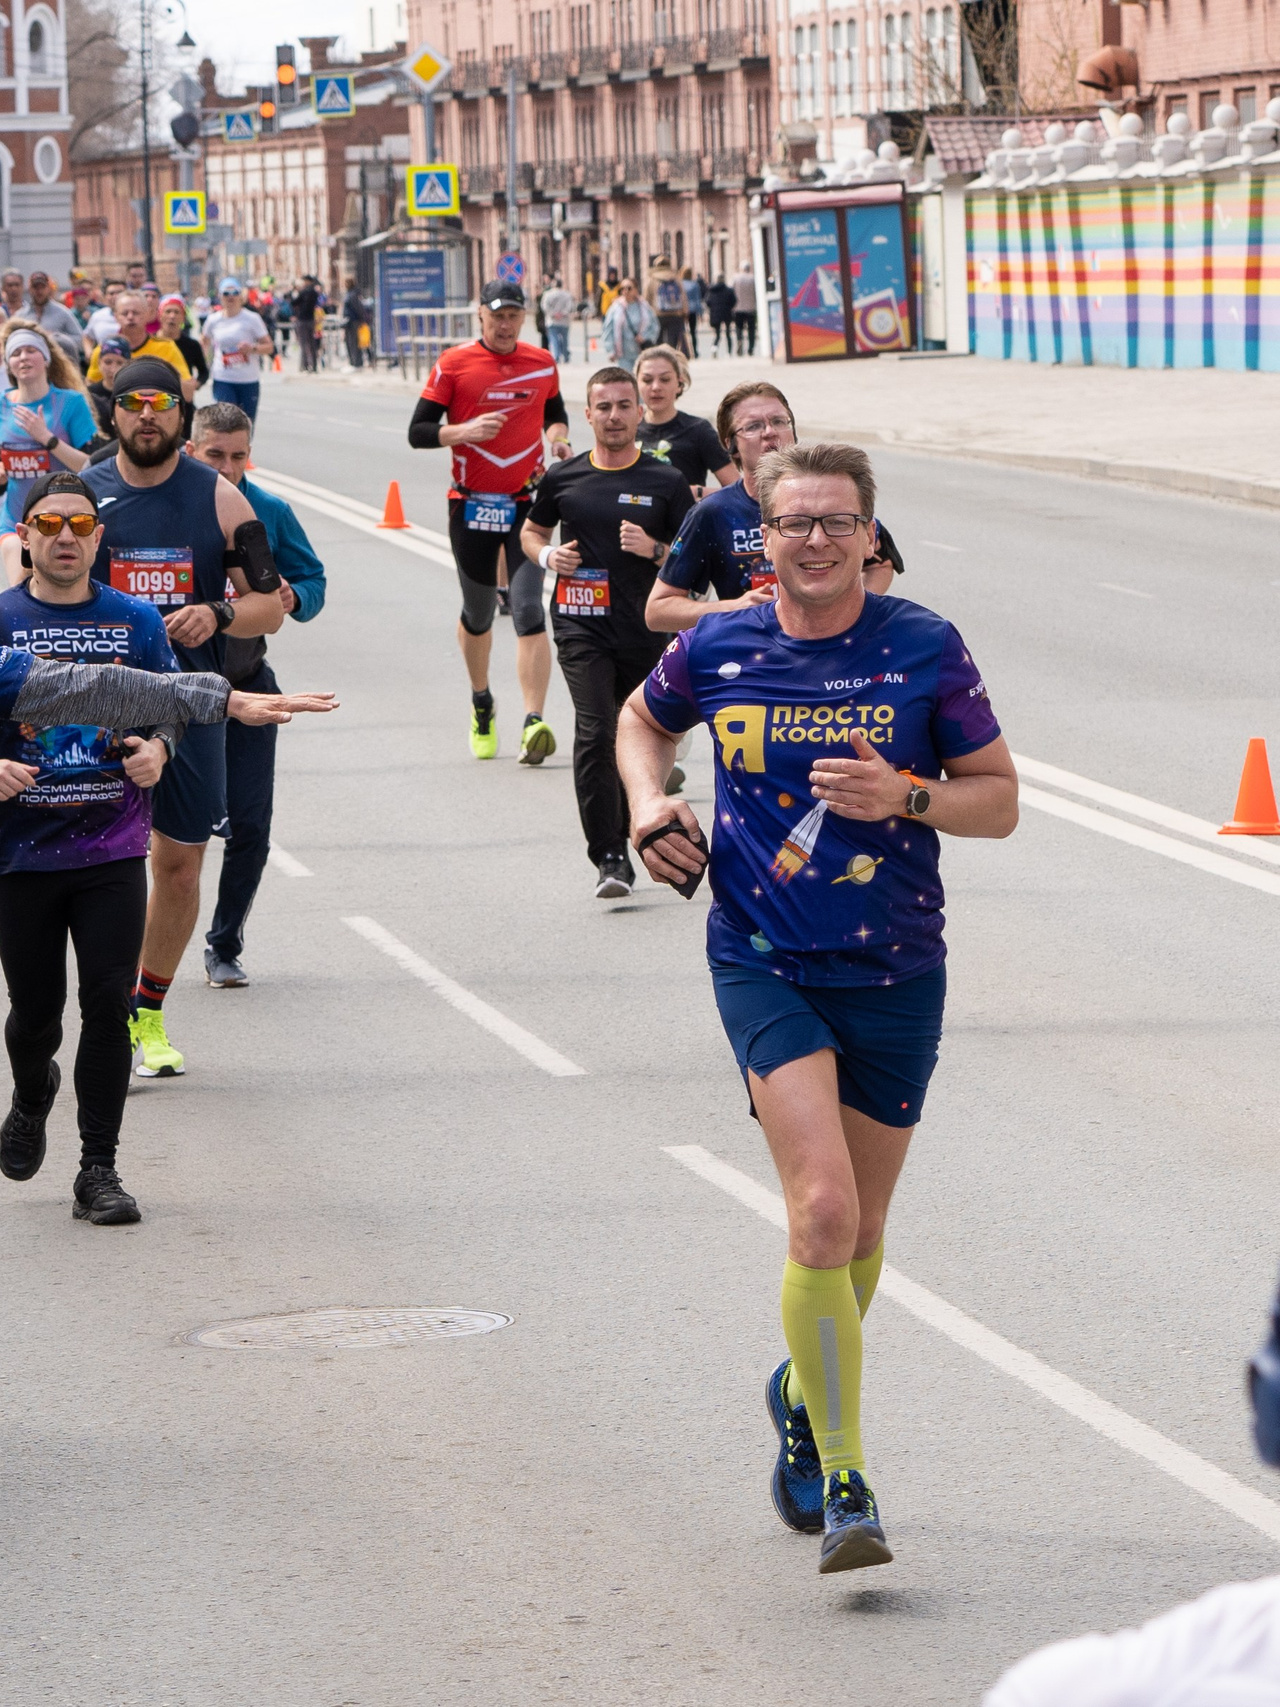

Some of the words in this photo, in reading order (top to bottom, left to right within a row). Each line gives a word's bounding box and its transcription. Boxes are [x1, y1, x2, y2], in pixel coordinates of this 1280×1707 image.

[8, 456, 39, 470] 1484
[475, 506, 505, 523] 2201
[127, 571, 176, 592] 1099
[566, 586, 594, 605] 1130
[13, 640, 129, 654] КОСМОС
[714, 705, 767, 773] Я
[772, 705, 895, 725] ПРОСТО
[20, 791, 124, 803] ПОЛУМАРАФОН
